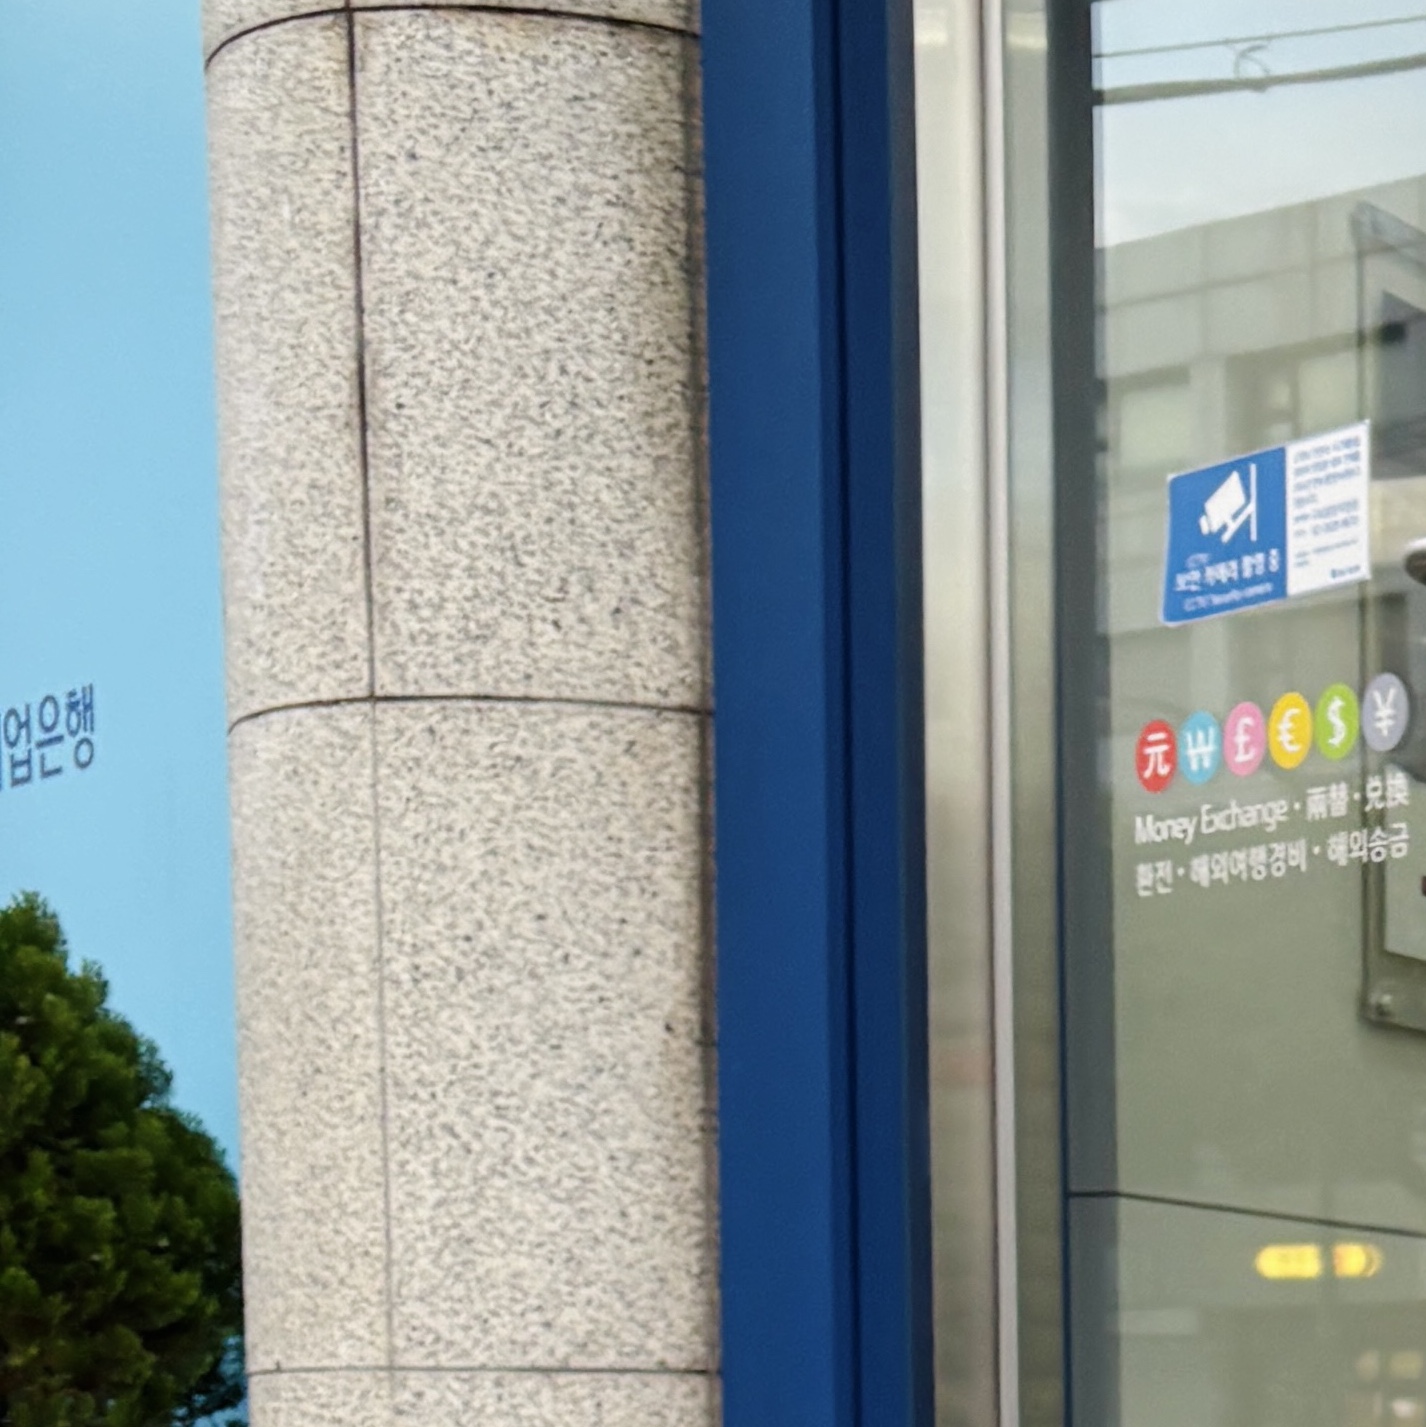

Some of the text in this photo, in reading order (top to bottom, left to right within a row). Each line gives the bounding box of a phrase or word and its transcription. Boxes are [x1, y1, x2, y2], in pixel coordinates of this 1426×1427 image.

[0, 683, 95, 792] 업은행
[1134, 814, 1198, 845] Money
[1199, 799, 1291, 833] Exchange
[1136, 860, 1174, 897] 환전
[1327, 822, 1410, 867] 해외송금
